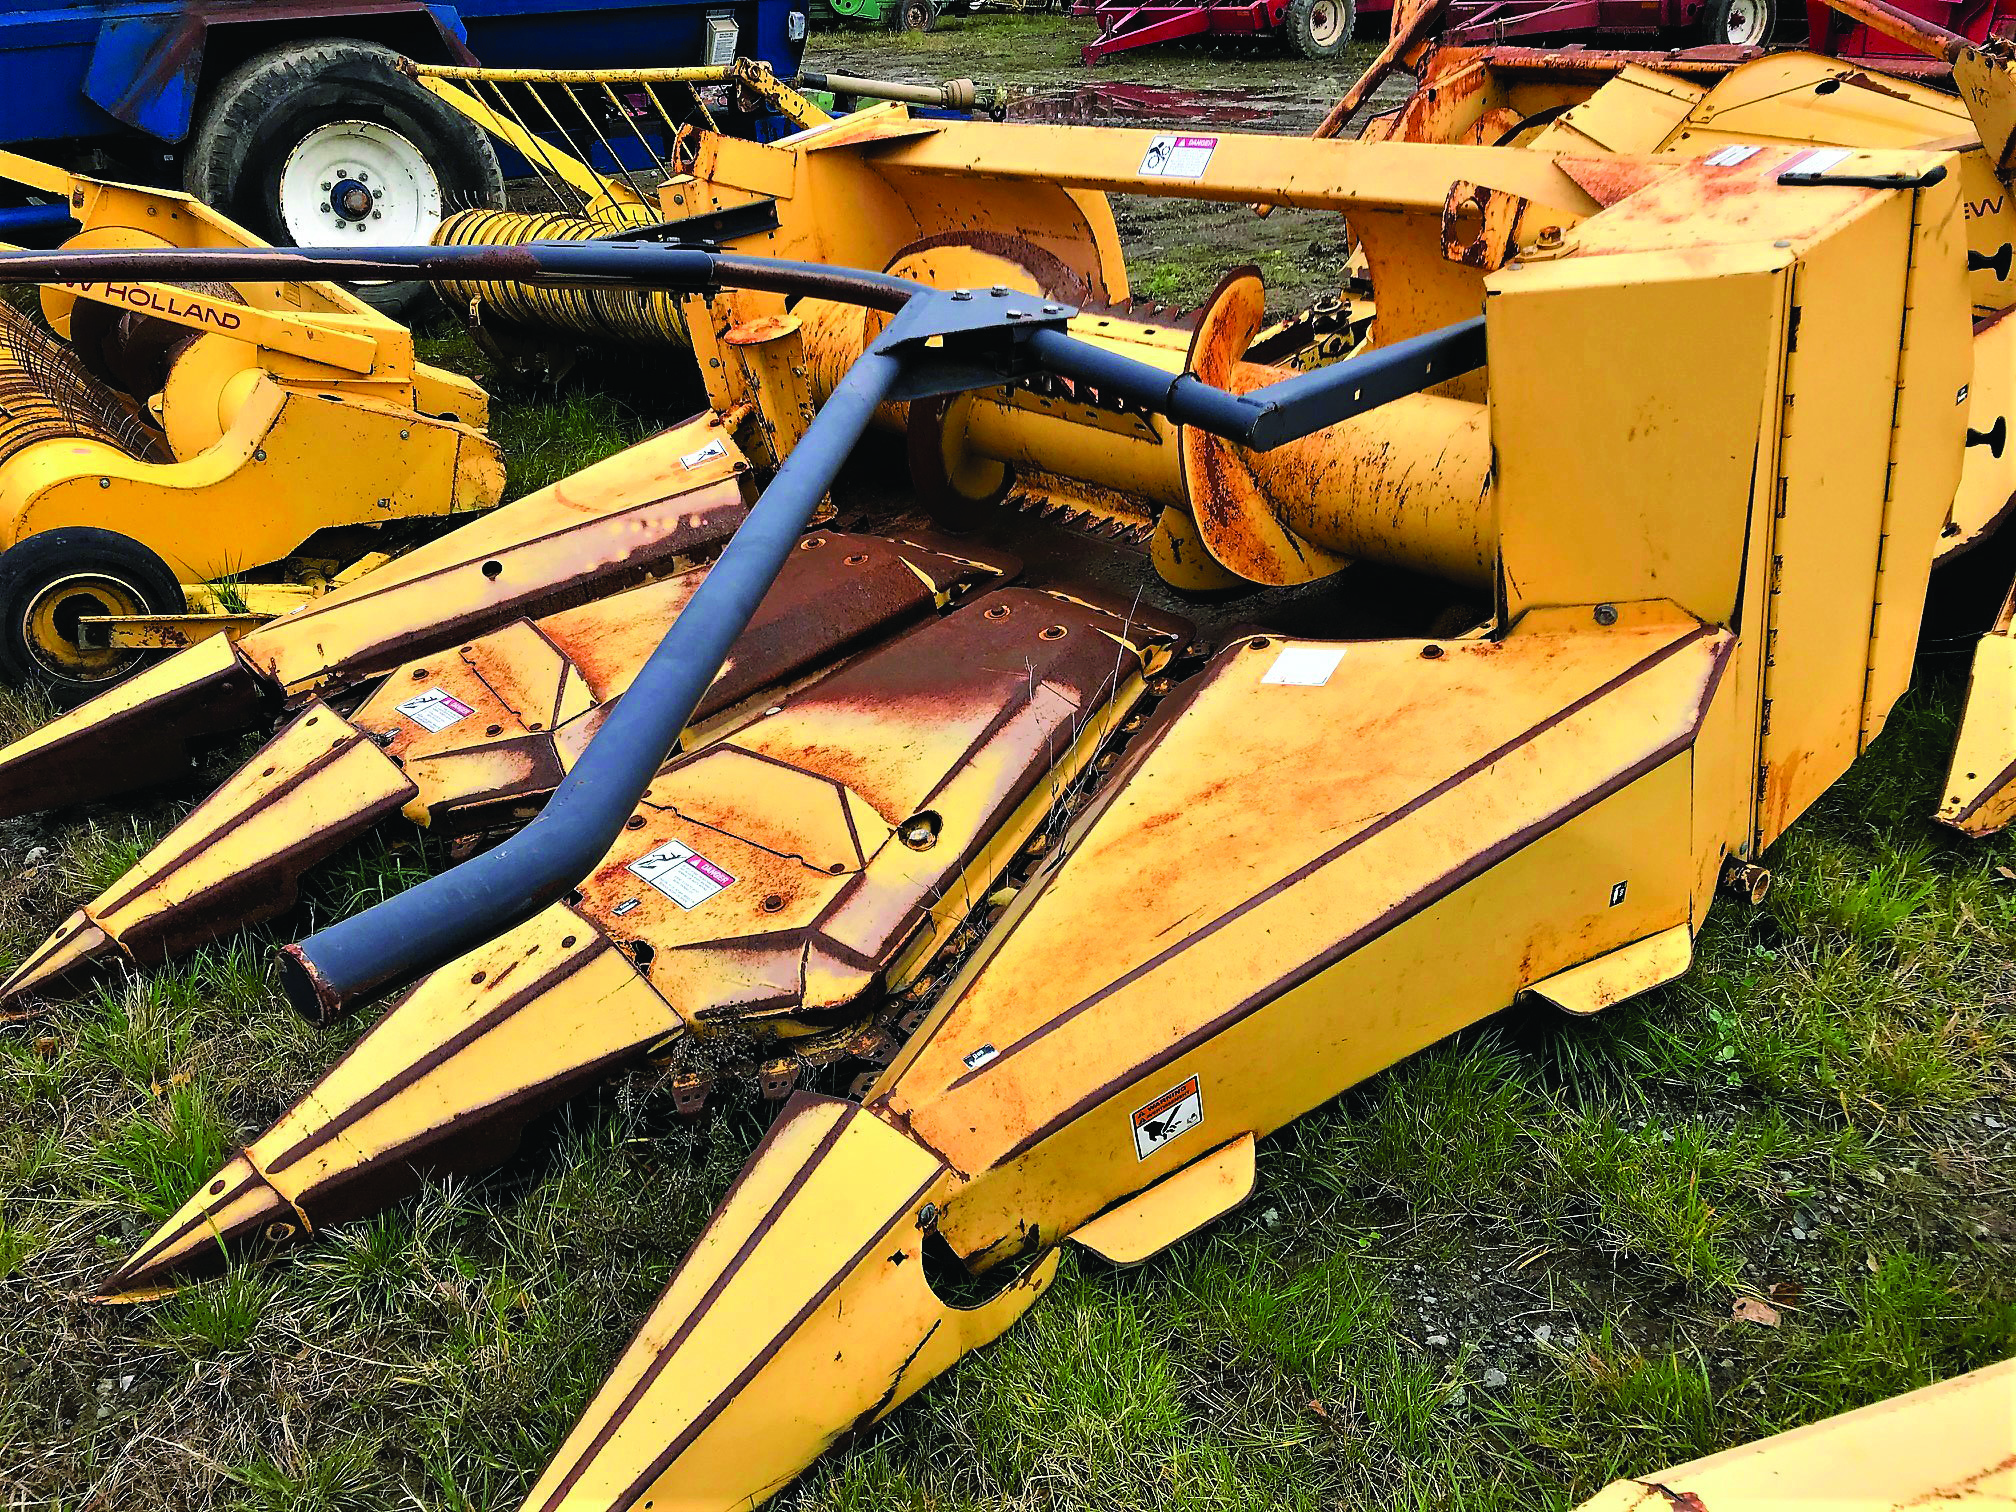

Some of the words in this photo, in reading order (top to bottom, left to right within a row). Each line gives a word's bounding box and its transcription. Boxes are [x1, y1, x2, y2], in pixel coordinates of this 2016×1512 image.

[105, 281, 241, 330] HOLLAND
[701, 863, 729, 884] DANGER
[1148, 1086, 1187, 1111] WARNING
